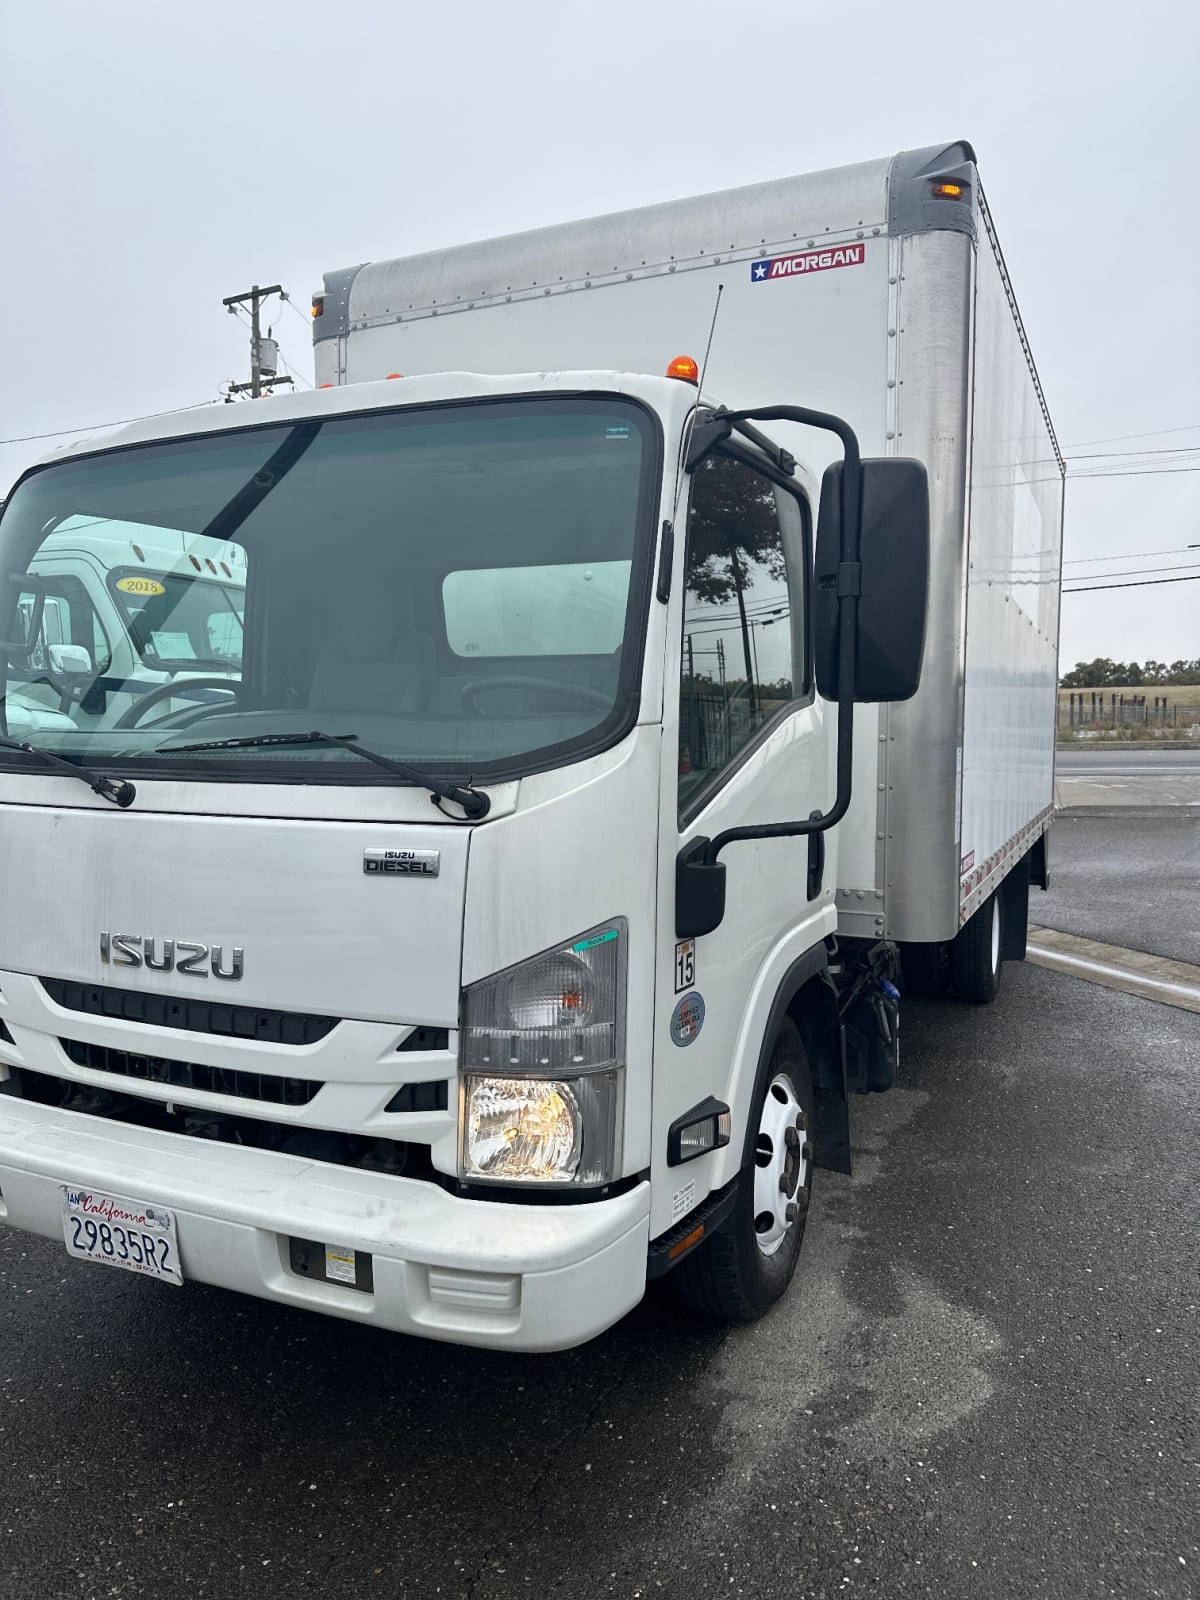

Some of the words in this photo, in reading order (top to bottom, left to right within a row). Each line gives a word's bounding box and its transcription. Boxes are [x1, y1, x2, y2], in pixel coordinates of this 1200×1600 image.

[771, 248, 860, 276] MORGAN
[127, 581, 158, 592] 2018
[366, 860, 433, 873] DIESEL
[385, 851, 415, 859] ISUZU
[100, 931, 244, 981] ISUZU
[678, 952, 693, 985] 15
[82, 1195, 154, 1228] California
[70, 1216, 174, 1273] 29835R2
[95, 1252, 155, 1272] dmv.ca.gov
